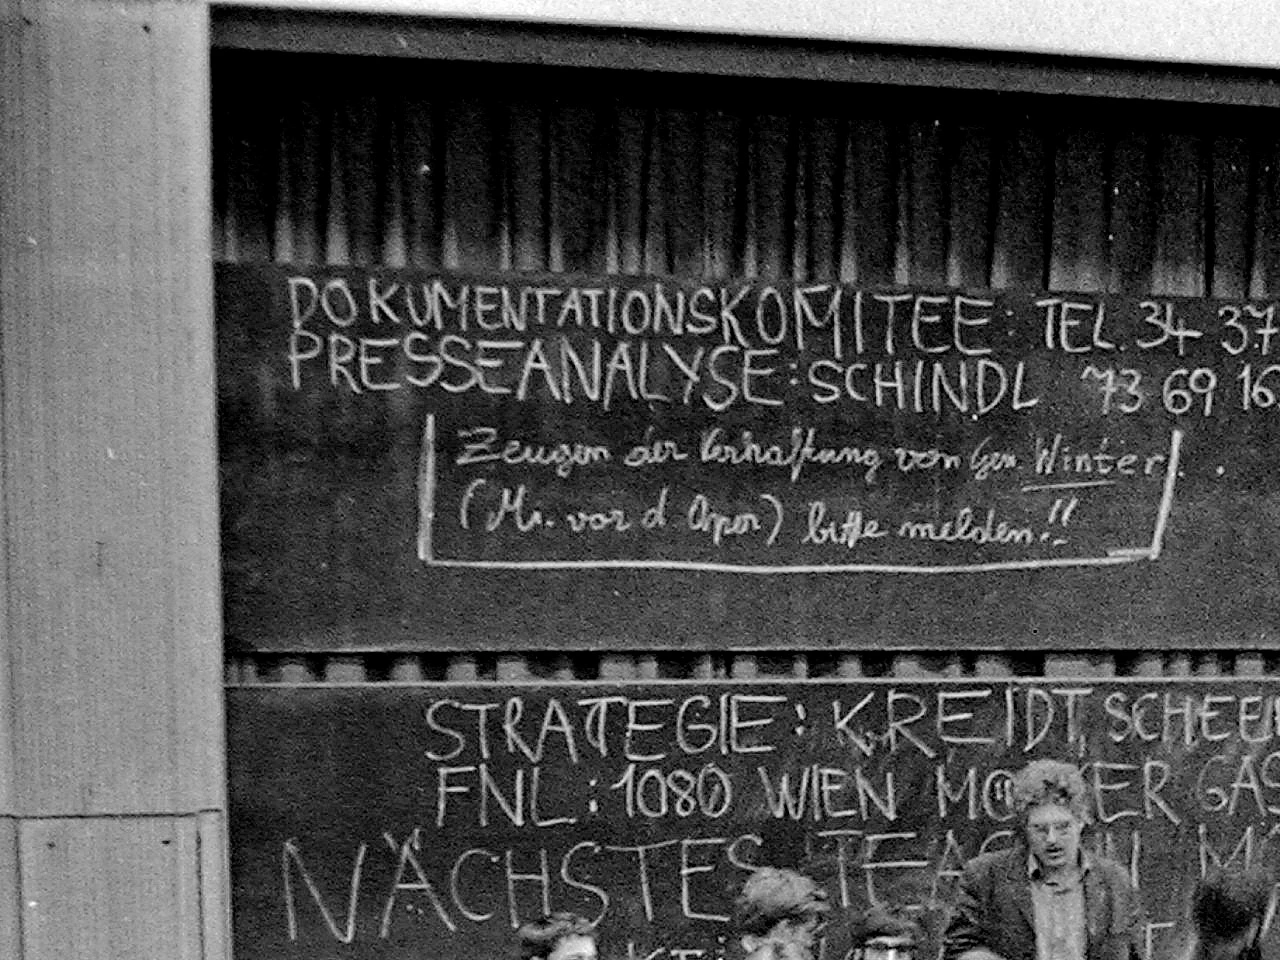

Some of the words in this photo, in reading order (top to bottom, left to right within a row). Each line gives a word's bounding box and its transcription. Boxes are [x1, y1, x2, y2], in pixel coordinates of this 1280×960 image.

[288, 277, 1016, 357] DOKUMENTATIONSKOMITEE:
[1036, 298, 1126, 353] TEL.
[1136, 301, 1203, 354] 34
[1218, 305, 1279, 356] 37
[288, 332, 800, 412] PRESSEANALYSE:
[808, 360, 1040, 414] SCHINDL
[1080, 367, 1142, 415] 73
[1163, 369, 1217, 416] 69
[456, 427, 611, 478] Zeugen
[1035, 432, 1166, 475] Winter
[802, 502, 888, 548] bitte
[424, 693, 807, 764] STRATEGIE:
[610, 763, 733, 818] 1080
[758, 764, 897, 822] WIEN
